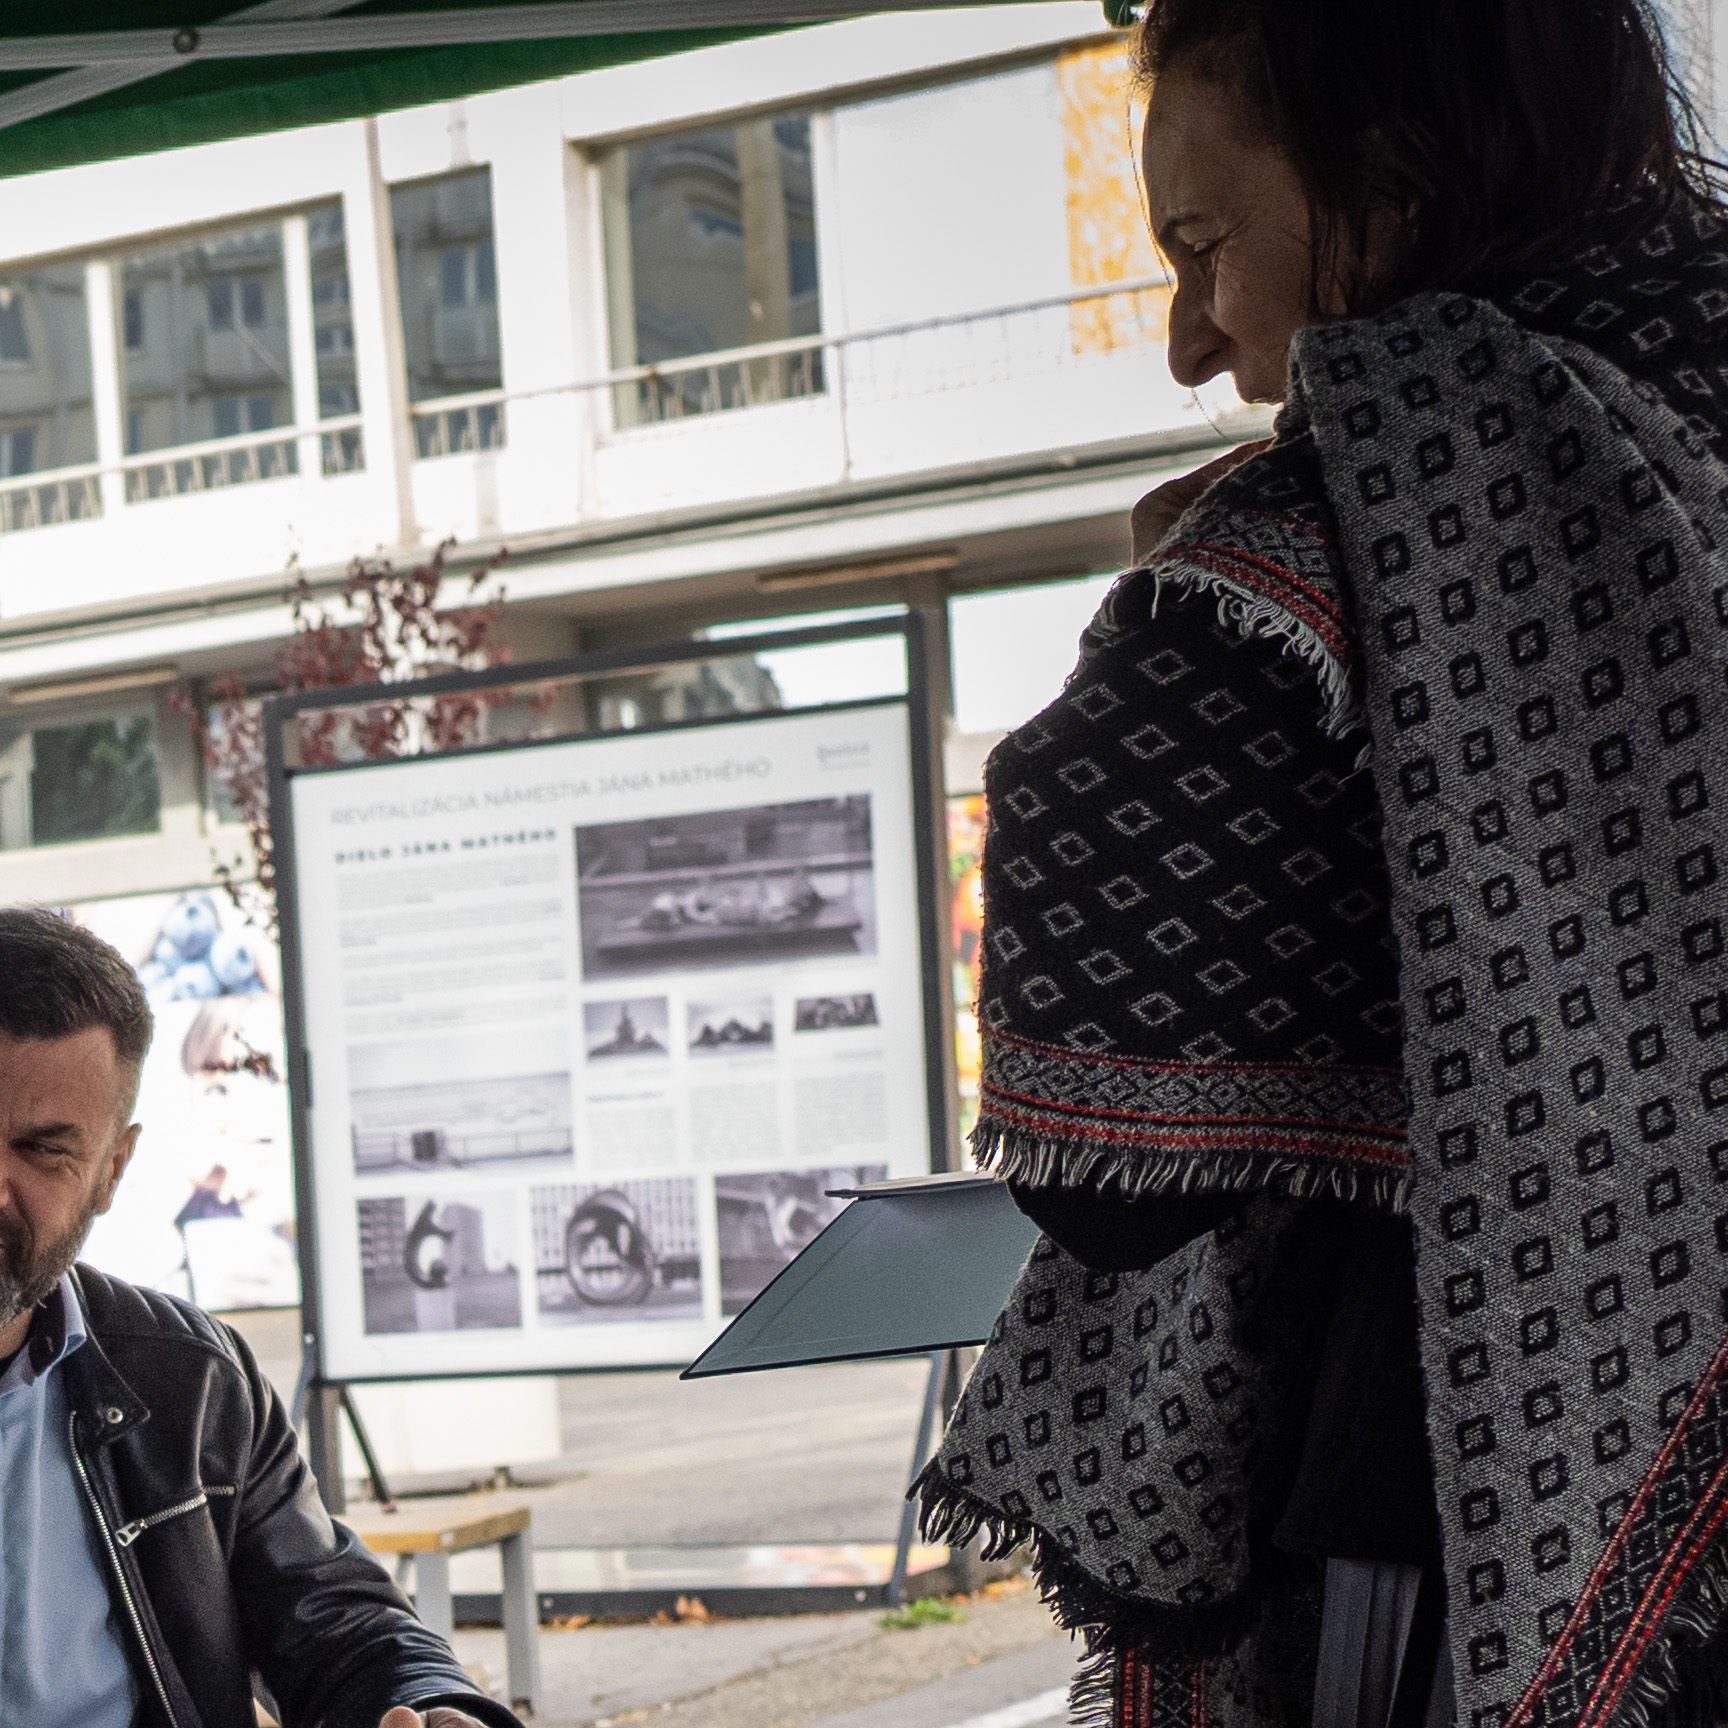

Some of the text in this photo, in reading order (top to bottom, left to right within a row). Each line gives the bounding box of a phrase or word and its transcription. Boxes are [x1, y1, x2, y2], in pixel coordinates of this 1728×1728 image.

[331, 756, 773, 825] REVITALIZÁCIA NÁMESTIA JÁNA MATHÉHO
[460, 827, 557, 849] MATHÉHO
